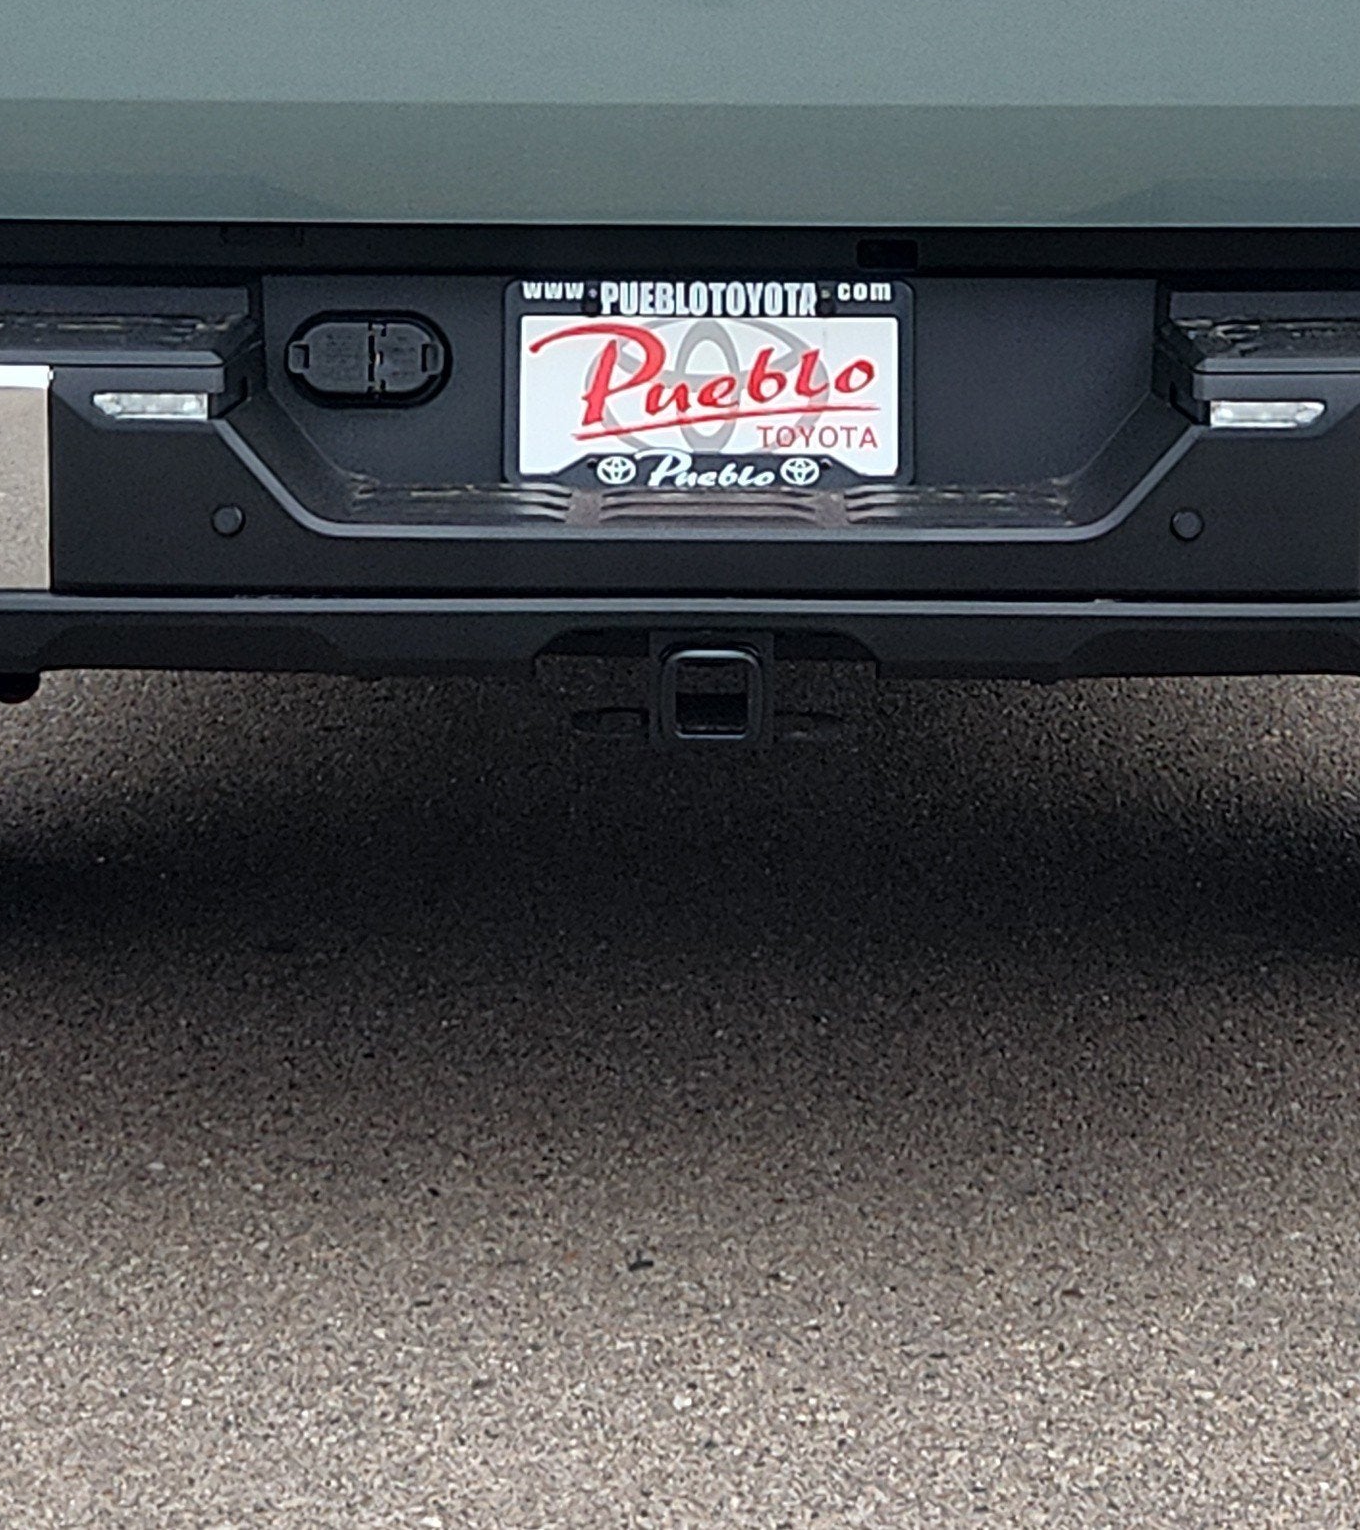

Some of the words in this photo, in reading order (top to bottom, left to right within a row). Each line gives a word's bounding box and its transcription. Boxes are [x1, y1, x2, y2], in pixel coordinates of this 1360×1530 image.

[529, 323, 875, 426] Pueblo
[756, 426, 878, 449] TOYOTA
[635, 448, 776, 488] Pueblo
